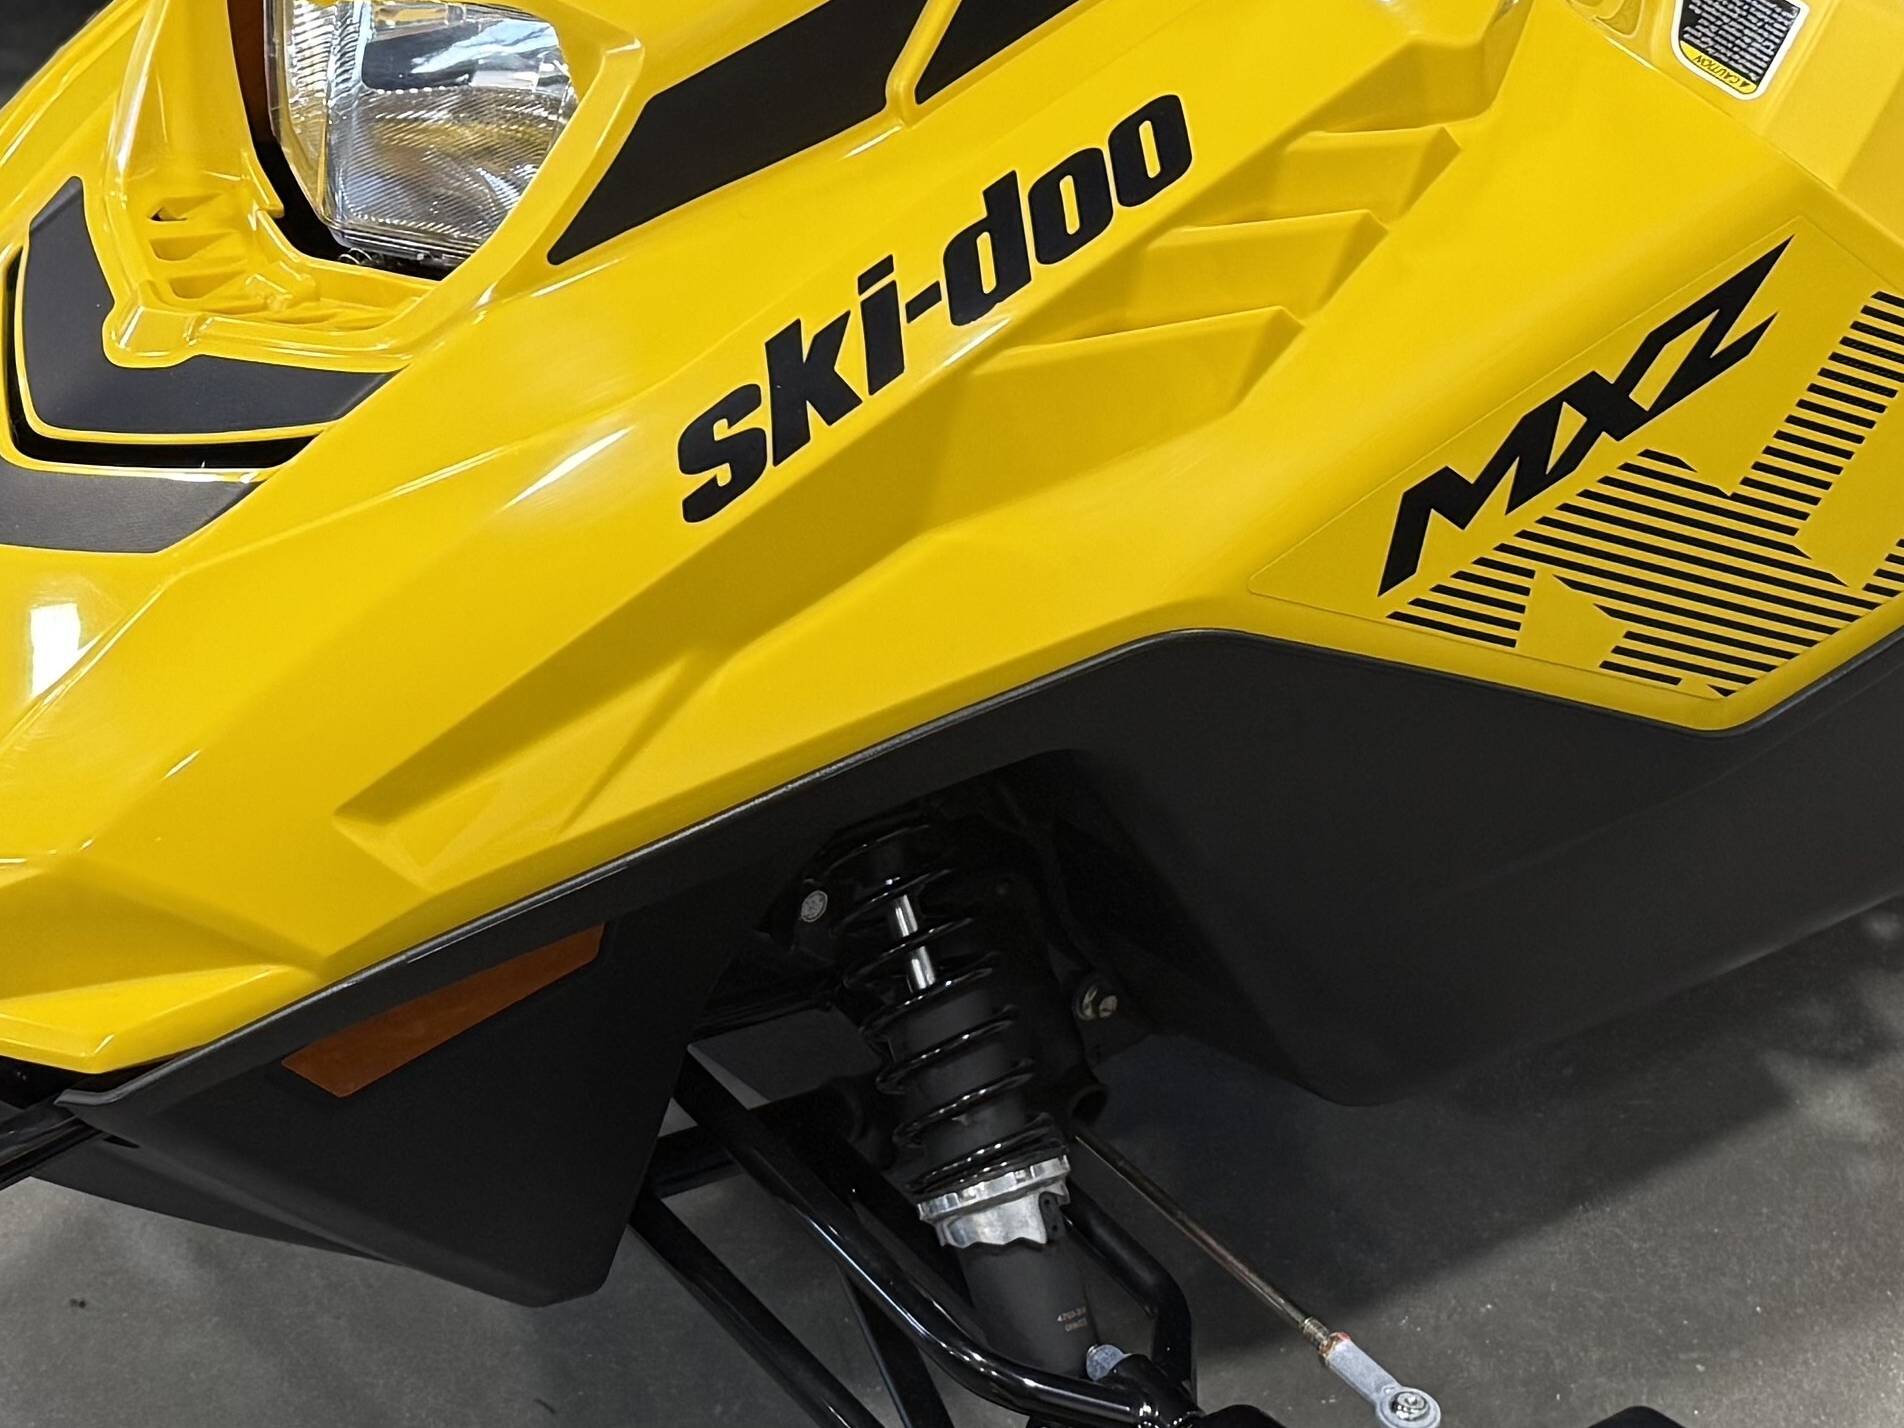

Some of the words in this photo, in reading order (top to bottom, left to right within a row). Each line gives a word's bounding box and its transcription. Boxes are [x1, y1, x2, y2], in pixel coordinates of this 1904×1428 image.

[1692, 55, 1741, 84] CAUTION
[677, 93, 1194, 524] ski-doo
[1378, 234, 1795, 598] MXZ
